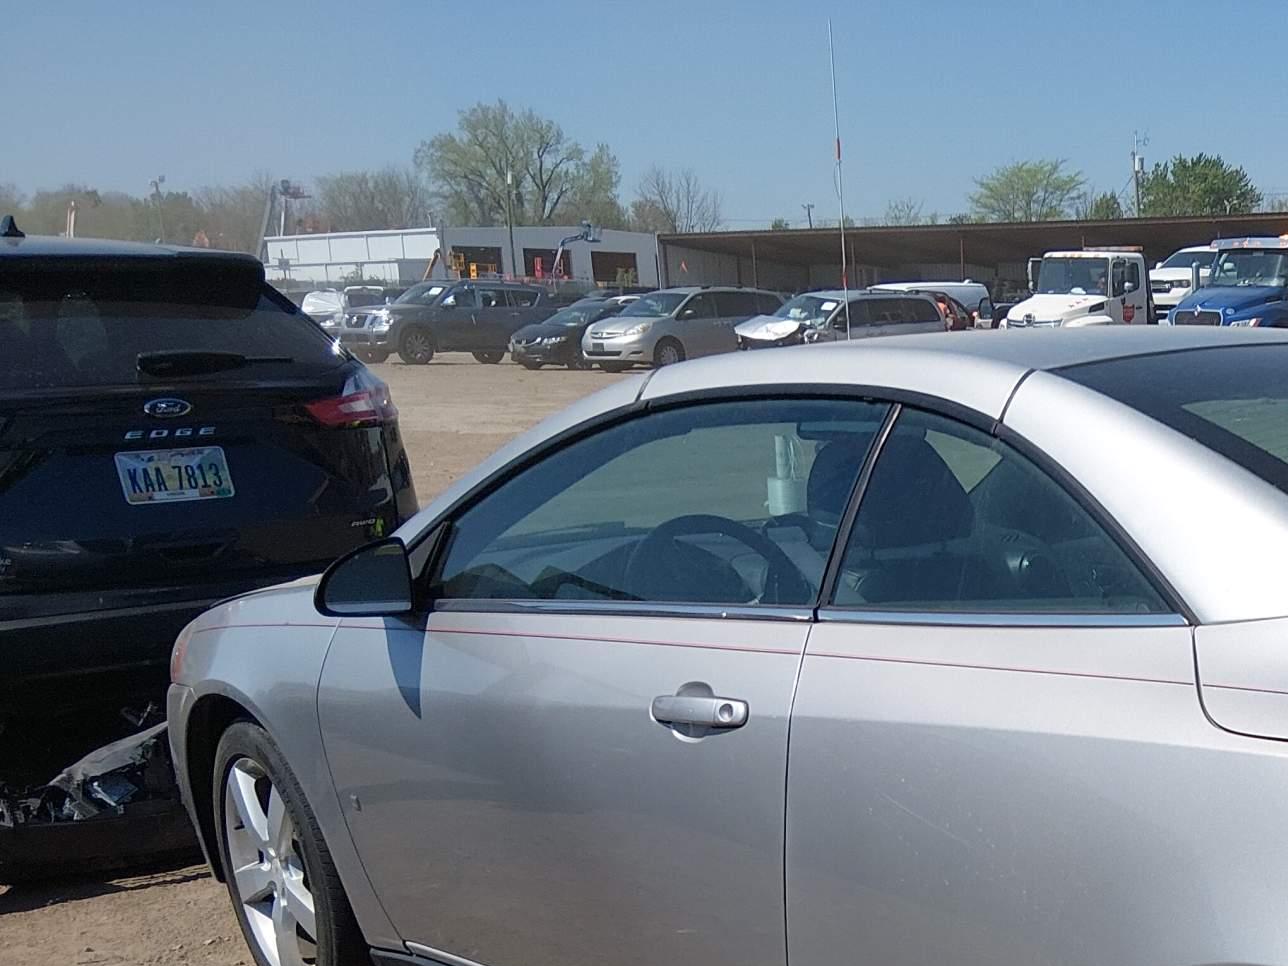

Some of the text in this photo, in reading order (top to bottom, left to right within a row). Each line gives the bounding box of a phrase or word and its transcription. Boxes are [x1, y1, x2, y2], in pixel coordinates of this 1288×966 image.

[124, 426, 217, 440] EDGE
[127, 463, 223, 495] KAA 7813
[351, 518, 376, 527] AWD
